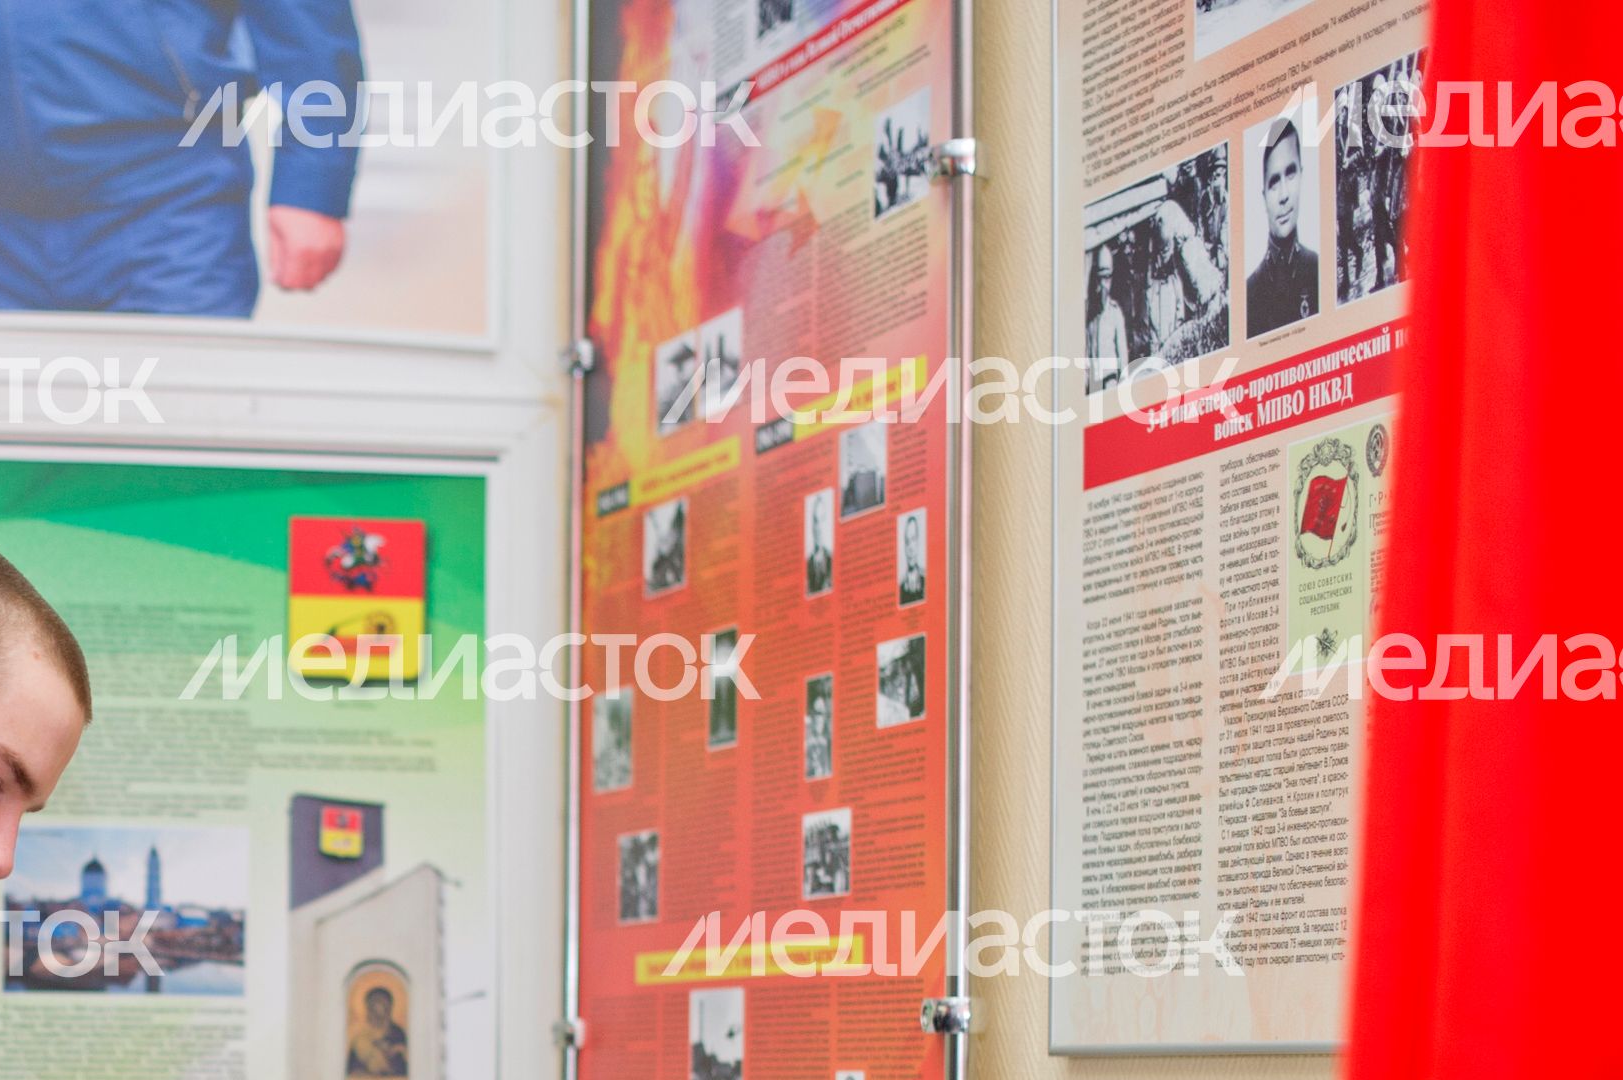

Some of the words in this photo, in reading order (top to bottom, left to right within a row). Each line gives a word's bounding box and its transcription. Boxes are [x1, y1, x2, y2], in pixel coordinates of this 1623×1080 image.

[1147, 405, 1170, 433] 3-й
[1172, 326, 1391, 425] инженерно-противохимический
[1214, 411, 1254, 441] войск
[1256, 394, 1305, 428] МПВО
[1309, 372, 1354, 411] НКВД
